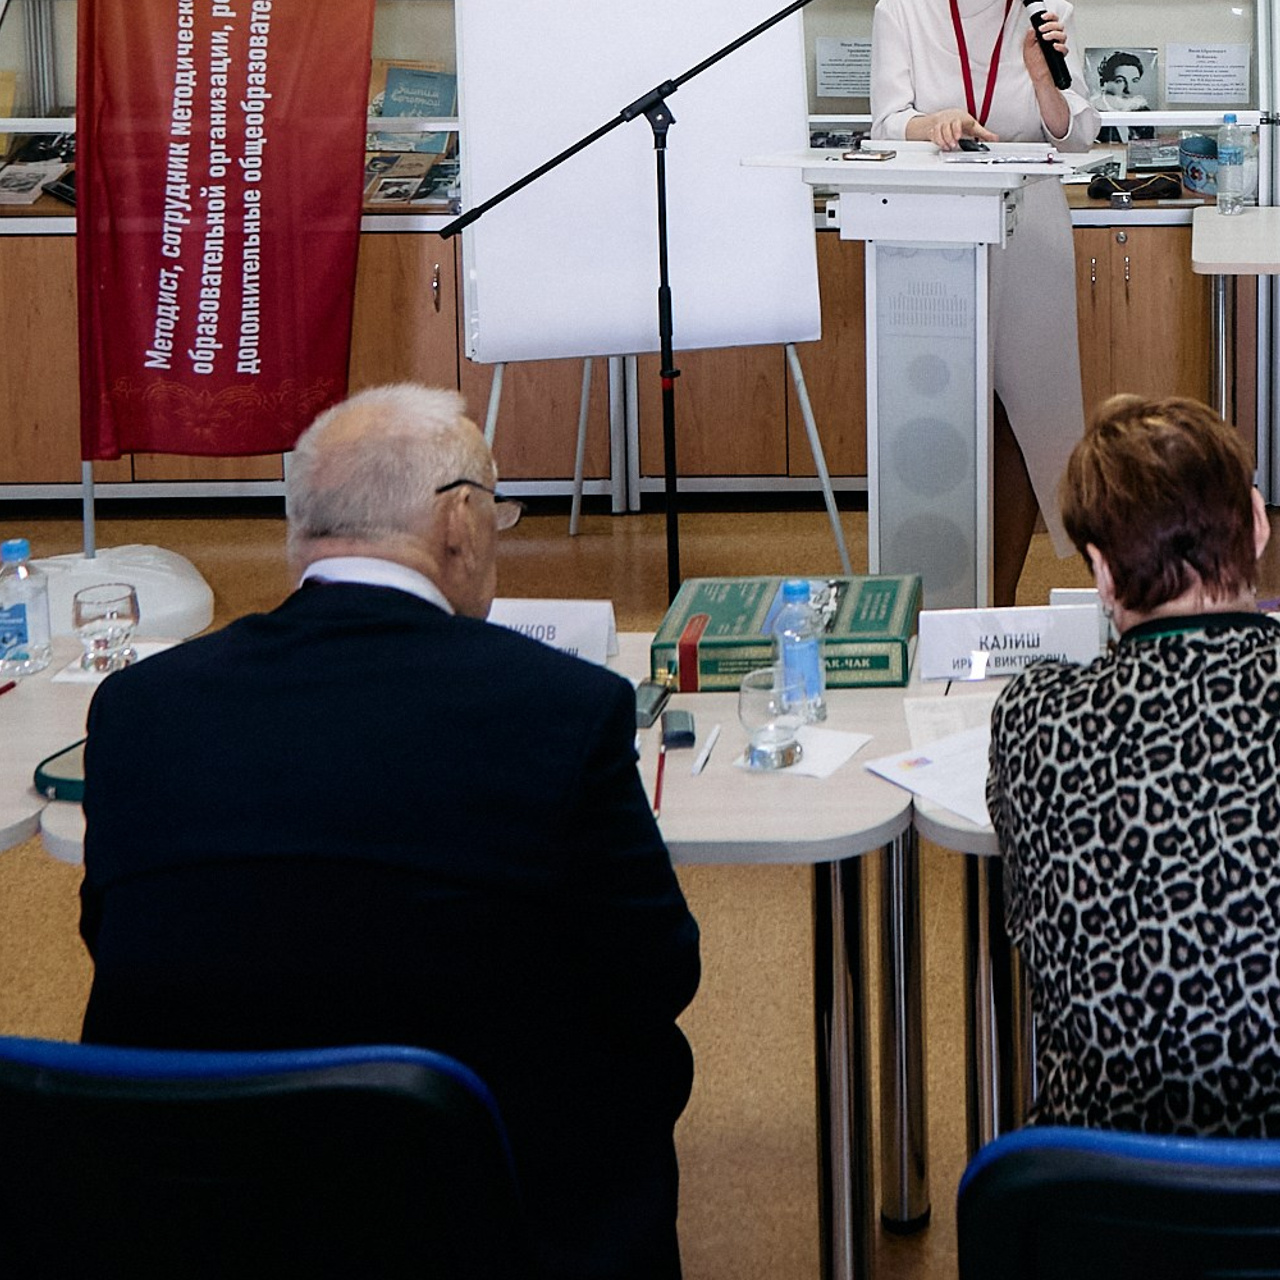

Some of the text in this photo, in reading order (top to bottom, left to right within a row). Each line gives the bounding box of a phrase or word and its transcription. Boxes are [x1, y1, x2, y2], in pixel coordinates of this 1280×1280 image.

[160, 142, 190, 259] сотрудник
[193, 185, 226, 375] образовательной
[210, 22, 235, 177] организации,
[144, 265, 184, 371] Методист,
[237, 189, 263, 375] дополнительные
[979, 633, 1041, 651] КАЛИШ
